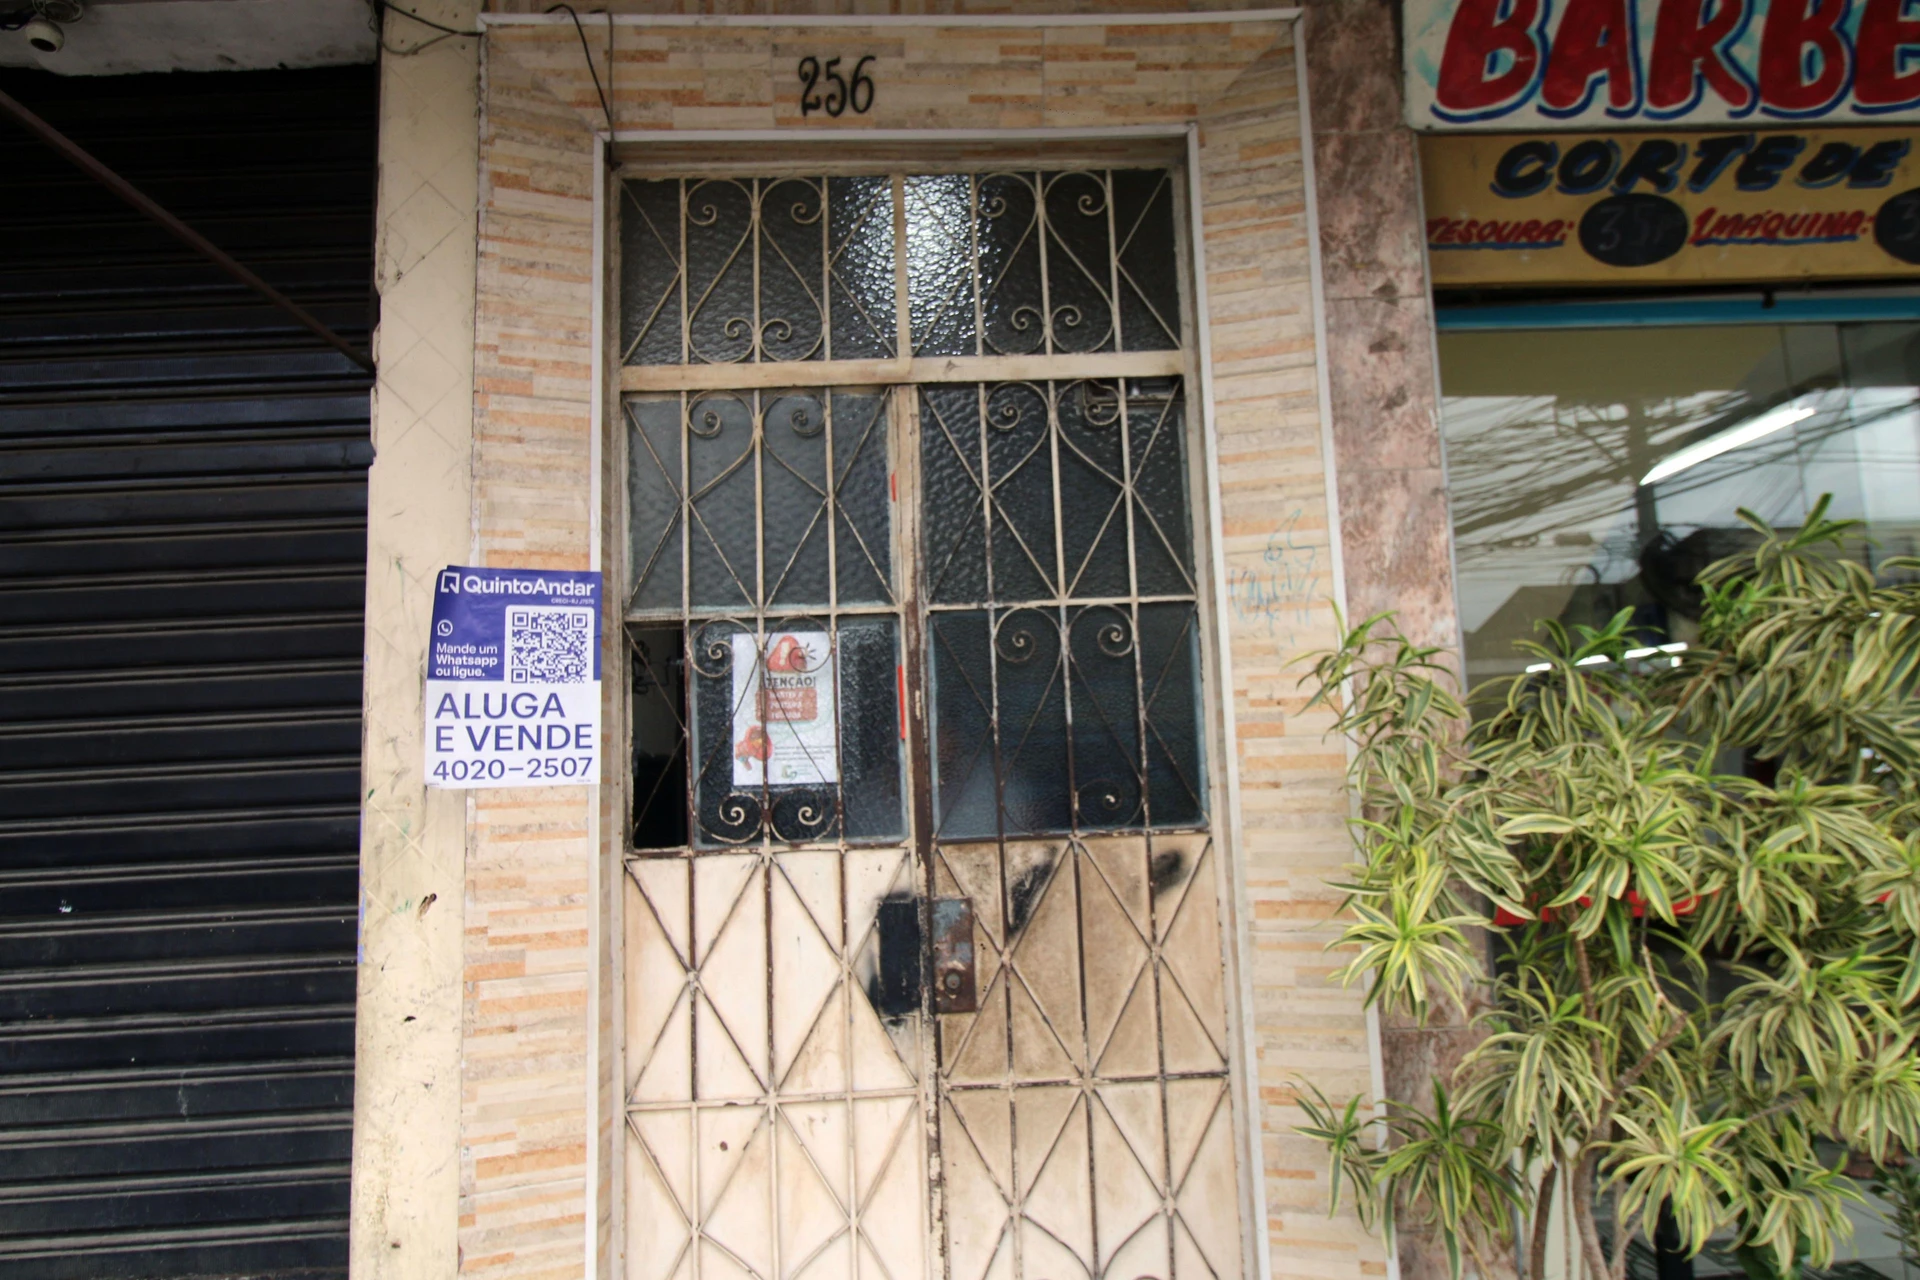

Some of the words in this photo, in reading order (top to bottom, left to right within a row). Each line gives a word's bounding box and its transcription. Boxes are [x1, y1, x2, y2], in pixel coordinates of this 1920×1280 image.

[798, 55, 876, 117] 256
[1491, 133, 1806, 198] CORTE
[1794, 137, 1910, 189] DE
[463, 575, 595, 597] QuintoAndar
[436, 643, 477, 655] Mande
[479, 645, 498, 654] um
[436, 654, 498, 668] Whatsapp
[436, 668, 451, 677] ou
[452, 666, 486, 679] ligue.
[434, 692, 567, 719] ALUGA
[436, 725, 455, 752] E
[465, 723, 593, 752] VENDE
[433, 757, 593, 781] 4020-2507
